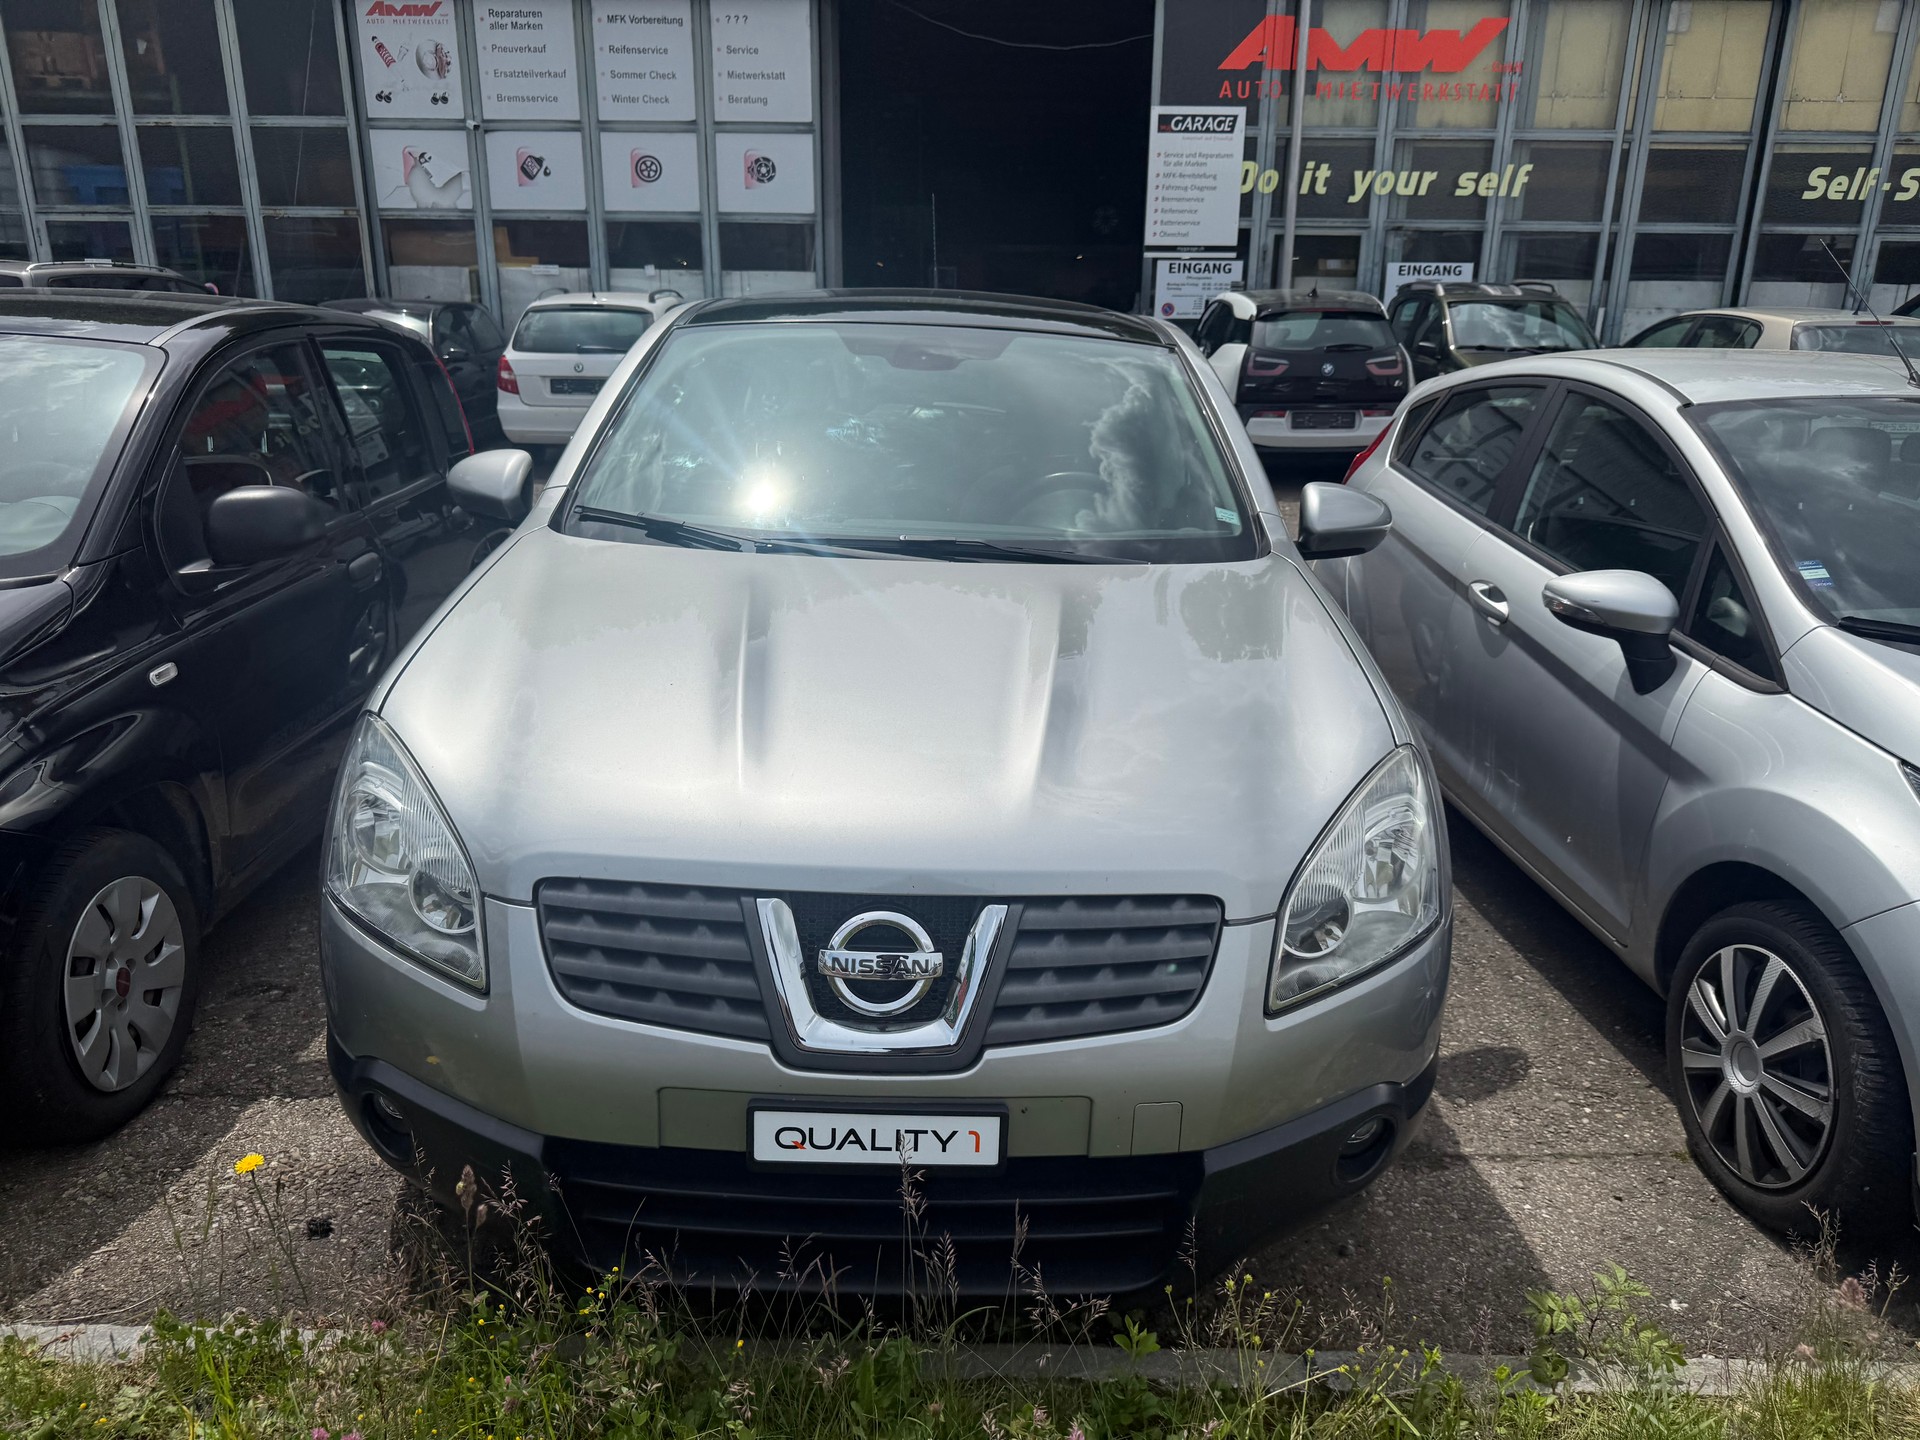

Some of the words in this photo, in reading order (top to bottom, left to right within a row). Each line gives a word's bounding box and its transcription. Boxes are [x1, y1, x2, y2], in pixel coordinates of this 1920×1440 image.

[365, 0, 443, 17] AMW
[488, 8, 543, 20] Reparaturen
[489, 21, 508, 31] aller
[510, 21, 543, 31] Marken
[606, 14, 626, 24] MFK
[628, 15, 684, 27] Vorbereitung
[491, 44, 547, 54] Pneuverkauf
[608, 44, 669, 55] Reifenservice
[726, 45, 759, 55] Service
[1217, 15, 1509, 73] AMW
[493, 68, 567, 79] Ersatzteilverkauf
[610, 69, 647, 80] Sommer
[649, 70, 677, 80] Check
[727, 70, 786, 80] Mietwerkstatt
[1219, 80, 1283, 99] AUTO
[1315, 80, 1518, 102] MIETWERKSTATT
[496, 93, 559, 103] Bremsservice
[611, 94, 640, 104] Winter
[642, 94, 670, 104] Check
[728, 94, 768, 106] Beratung
[1241, 161, 1280, 194] Do
[1299, 161, 1332, 195] it
[1348, 169, 1438, 203] your
[1454, 163, 1534, 198] self
[1168, 262, 1232, 274] EINGANG
[1398, 264, 1463, 276] EINGANG
[830, 956, 930, 976] NISSAN
[774, 1126, 959, 1153] QUALITY
